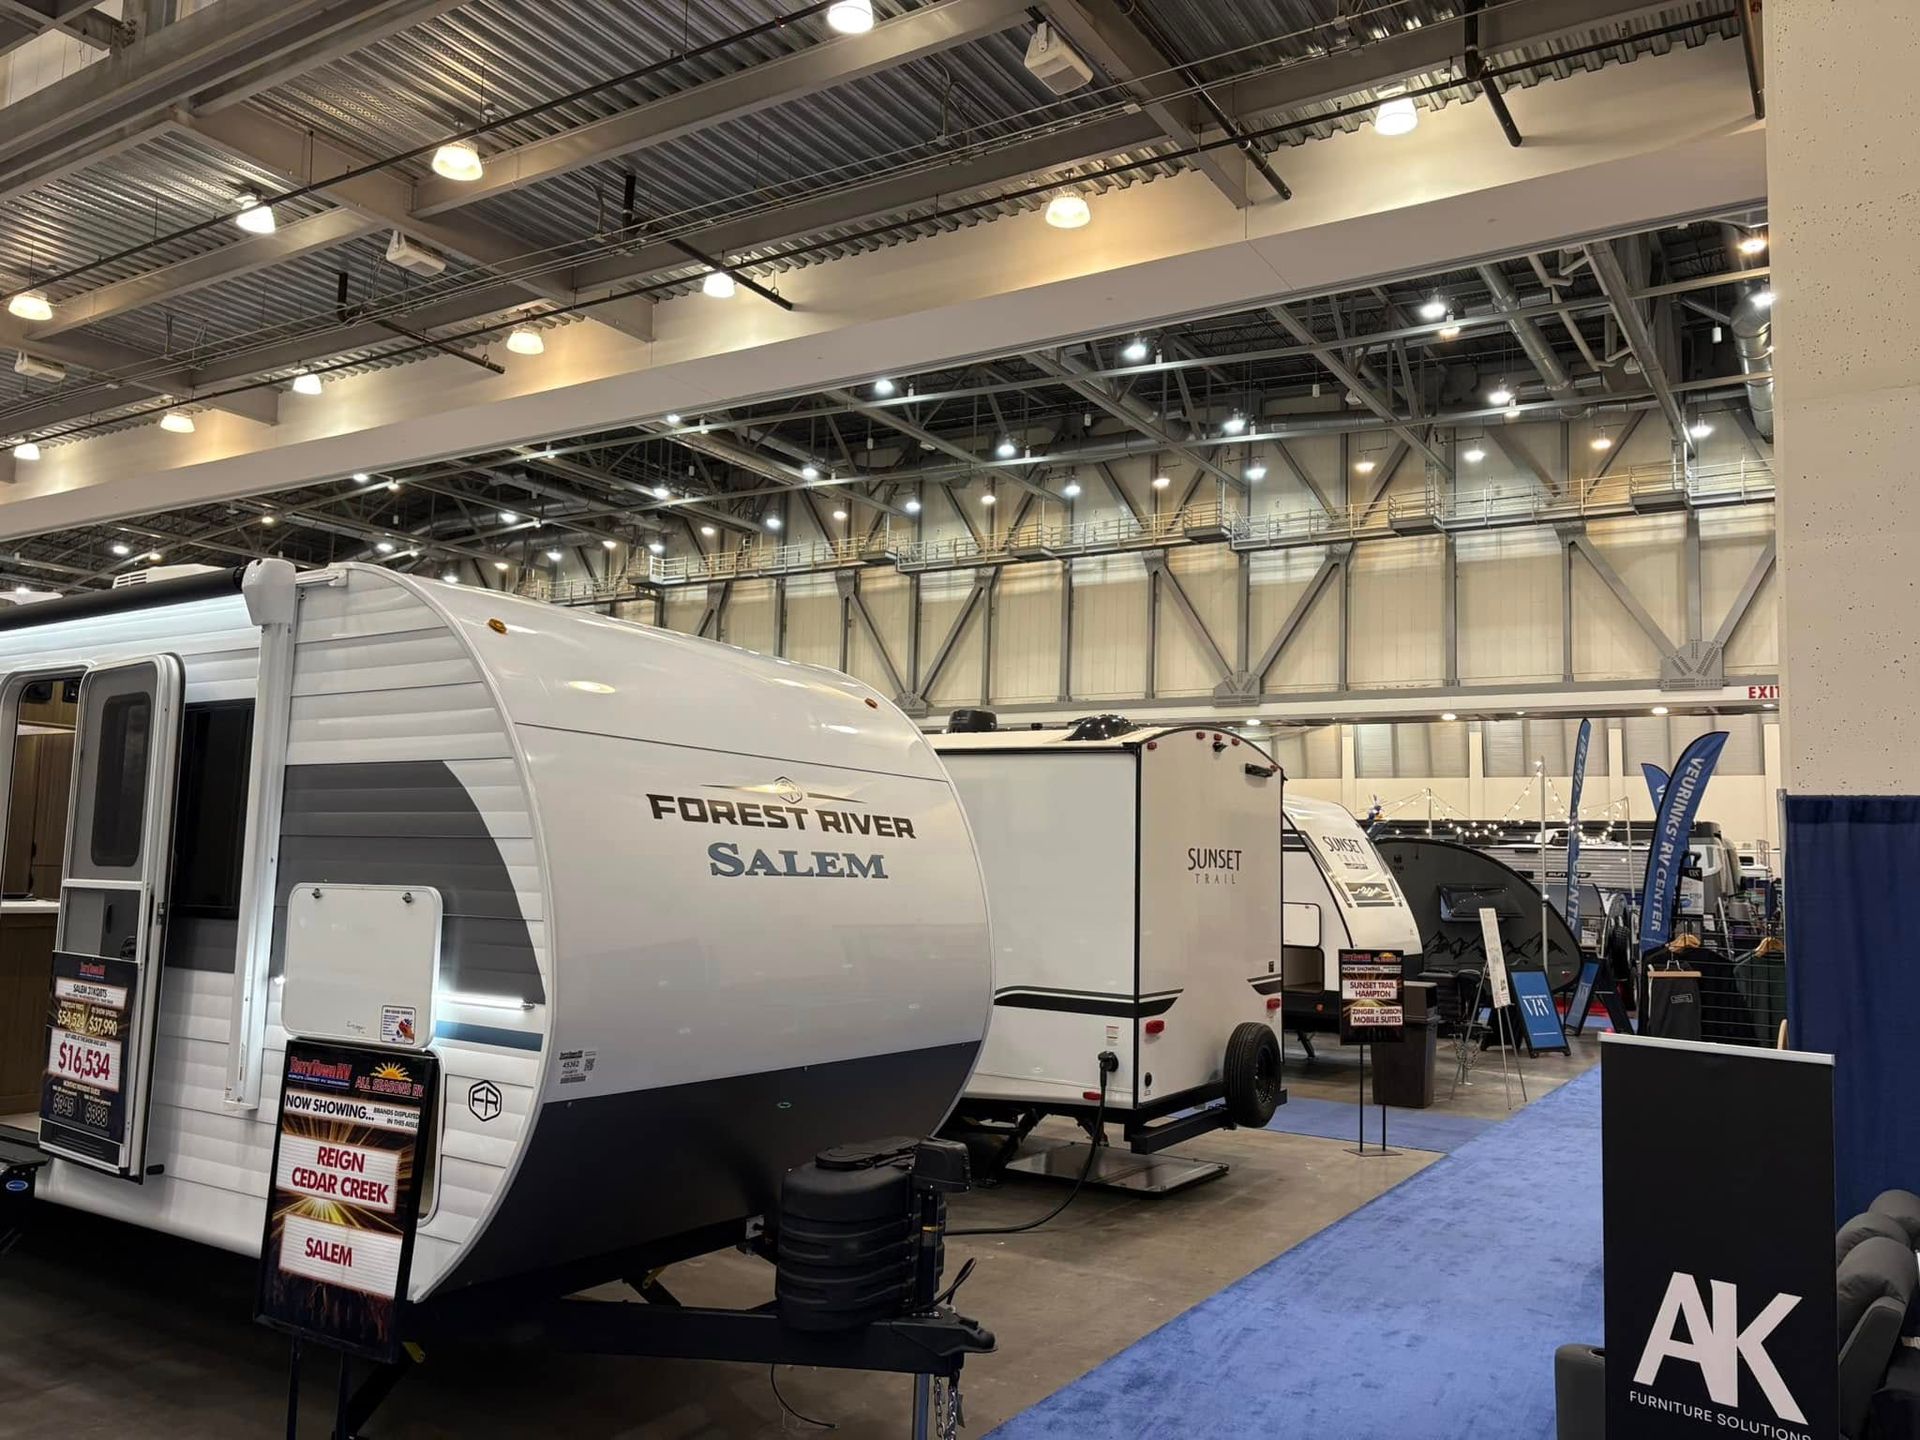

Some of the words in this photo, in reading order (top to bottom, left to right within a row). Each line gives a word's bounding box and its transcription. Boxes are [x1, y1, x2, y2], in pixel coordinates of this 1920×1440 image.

[1665, 757, 1705, 841] VEURINKS'
[645, 793, 809, 830] FOREST
[814, 809, 917, 839] RIVER
[1321, 835, 1365, 855] SUNSET
[1658, 841, 1675, 867] RV
[706, 842, 889, 879] SALEM
[1187, 847, 1242, 871] SUNSET
[1194, 872, 1237, 885] TRAIL
[1651, 867, 1669, 932] CENTER
[73, 983, 88, 994] SALEM
[1350, 981, 1376, 989] SUNSET
[1377, 981, 1396, 989] TRAIL
[1355, 990, 1391, 998] HAMPTON
[88, 1015, 118, 1036] $37,990
[1353, 1016, 1380, 1024] MOBILE
[1380, 1015, 1402, 1024] SUITES
[58, 1040, 110, 1081] $16,534
[355, 1075, 371, 1090] ALL
[372, 1078, 412, 1096] SEASONS
[285, 1094, 312, 1111] NOW
[312, 1099, 375, 1122] SHOWING...
[373, 1107, 394, 1116] BRANDS
[394, 1110, 420, 1120] DISPLAYED
[393, 1119, 405, 1127] THIS
[405, 1121, 419, 1129] AISLE
[317, 1146, 366, 1173] REIGN
[291, 1166, 338, 1195] CEDAR
[340, 1176, 390, 1204] CREEK
[304, 1236, 353, 1268] SALEM
[1633, 1271, 1809, 1426] AK
[1629, 1390, 1714, 1422] FURNITURE
